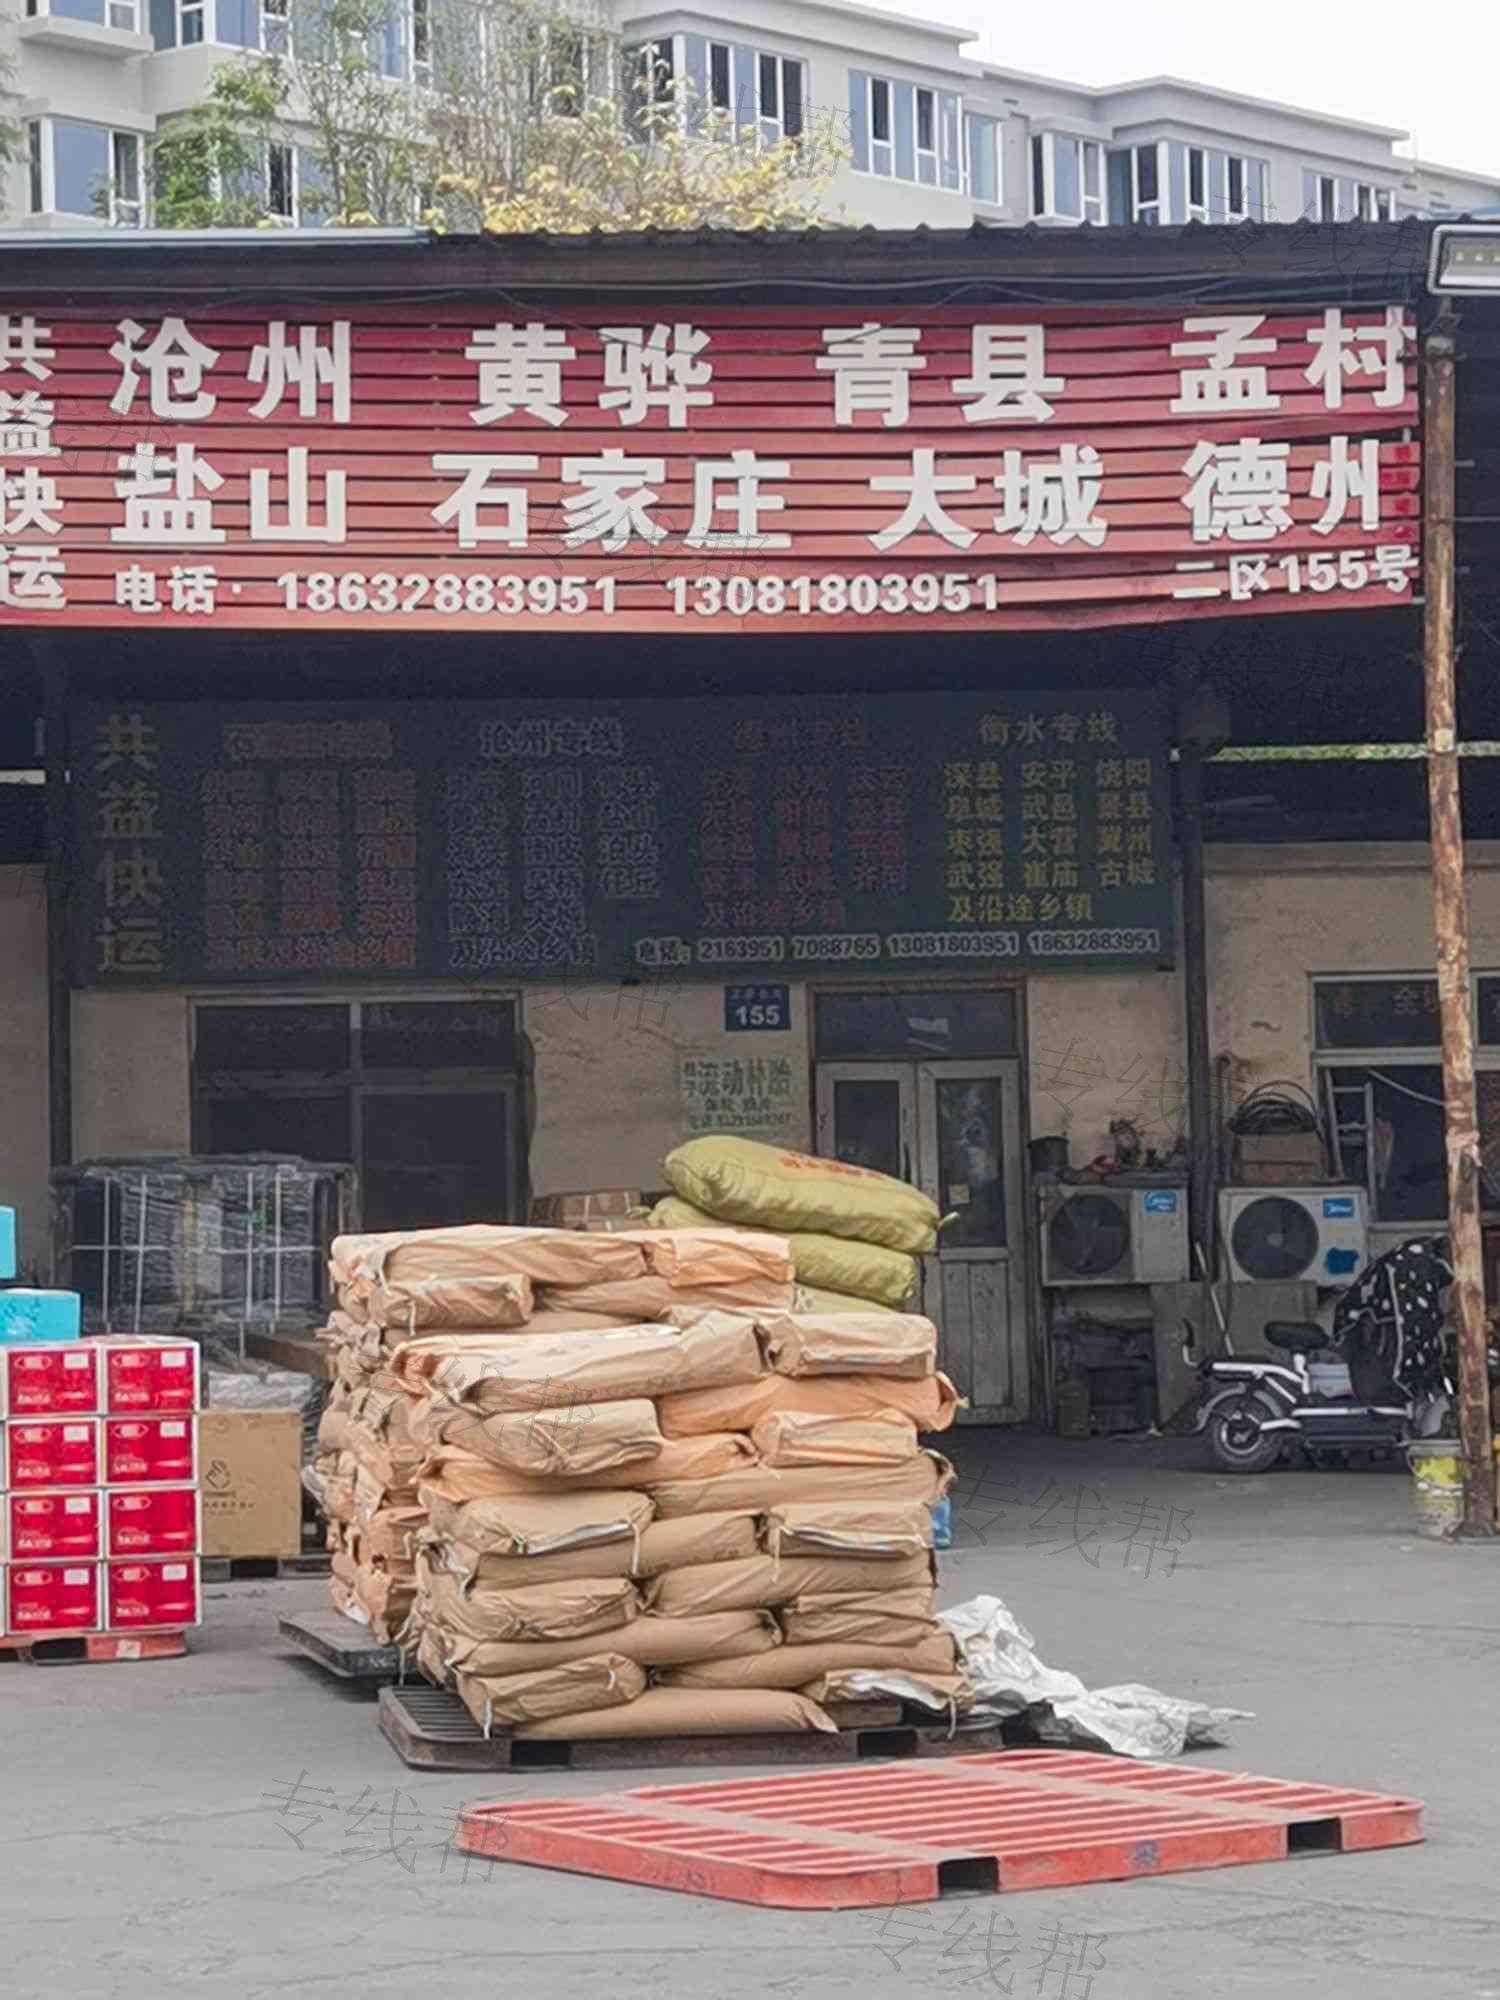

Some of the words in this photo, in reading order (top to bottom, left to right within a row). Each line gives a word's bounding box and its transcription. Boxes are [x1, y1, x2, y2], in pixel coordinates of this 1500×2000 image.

[108, 317, 352, 424] 沧州
[464, 322, 715, 427] 黄骅
[815, 322, 1066, 427] 青县
[1170, 307, 1416, 414] 孟村
[110, 442, 348, 544] 盐山
[431, 447, 793, 551] 石家庄
[868, 443, 1108, 551] 大城
[1181, 435, 1380, 544] 德州
[276, 571, 617, 617] 18632883951
[667, 573, 999, 616] 13081803951
[1171, 545, 1419, 602] 二区155号
[979, 713, 1117, 743] 衡水专线
[1021, 760, 1076, 787] 安平
[93, 713, 163, 974] 共益快运
[945, 863, 1004, 889] 武强
[947, 894, 1092, 922] 及沿途乡镇
[697, 937, 784, 962] 2163951
[793, 935, 881, 959] 7088765
[889, 933, 1019, 956] 13081803951
[1027, 930, 1161, 954] 18632883951
[736, 1004, 780, 1026] 155
